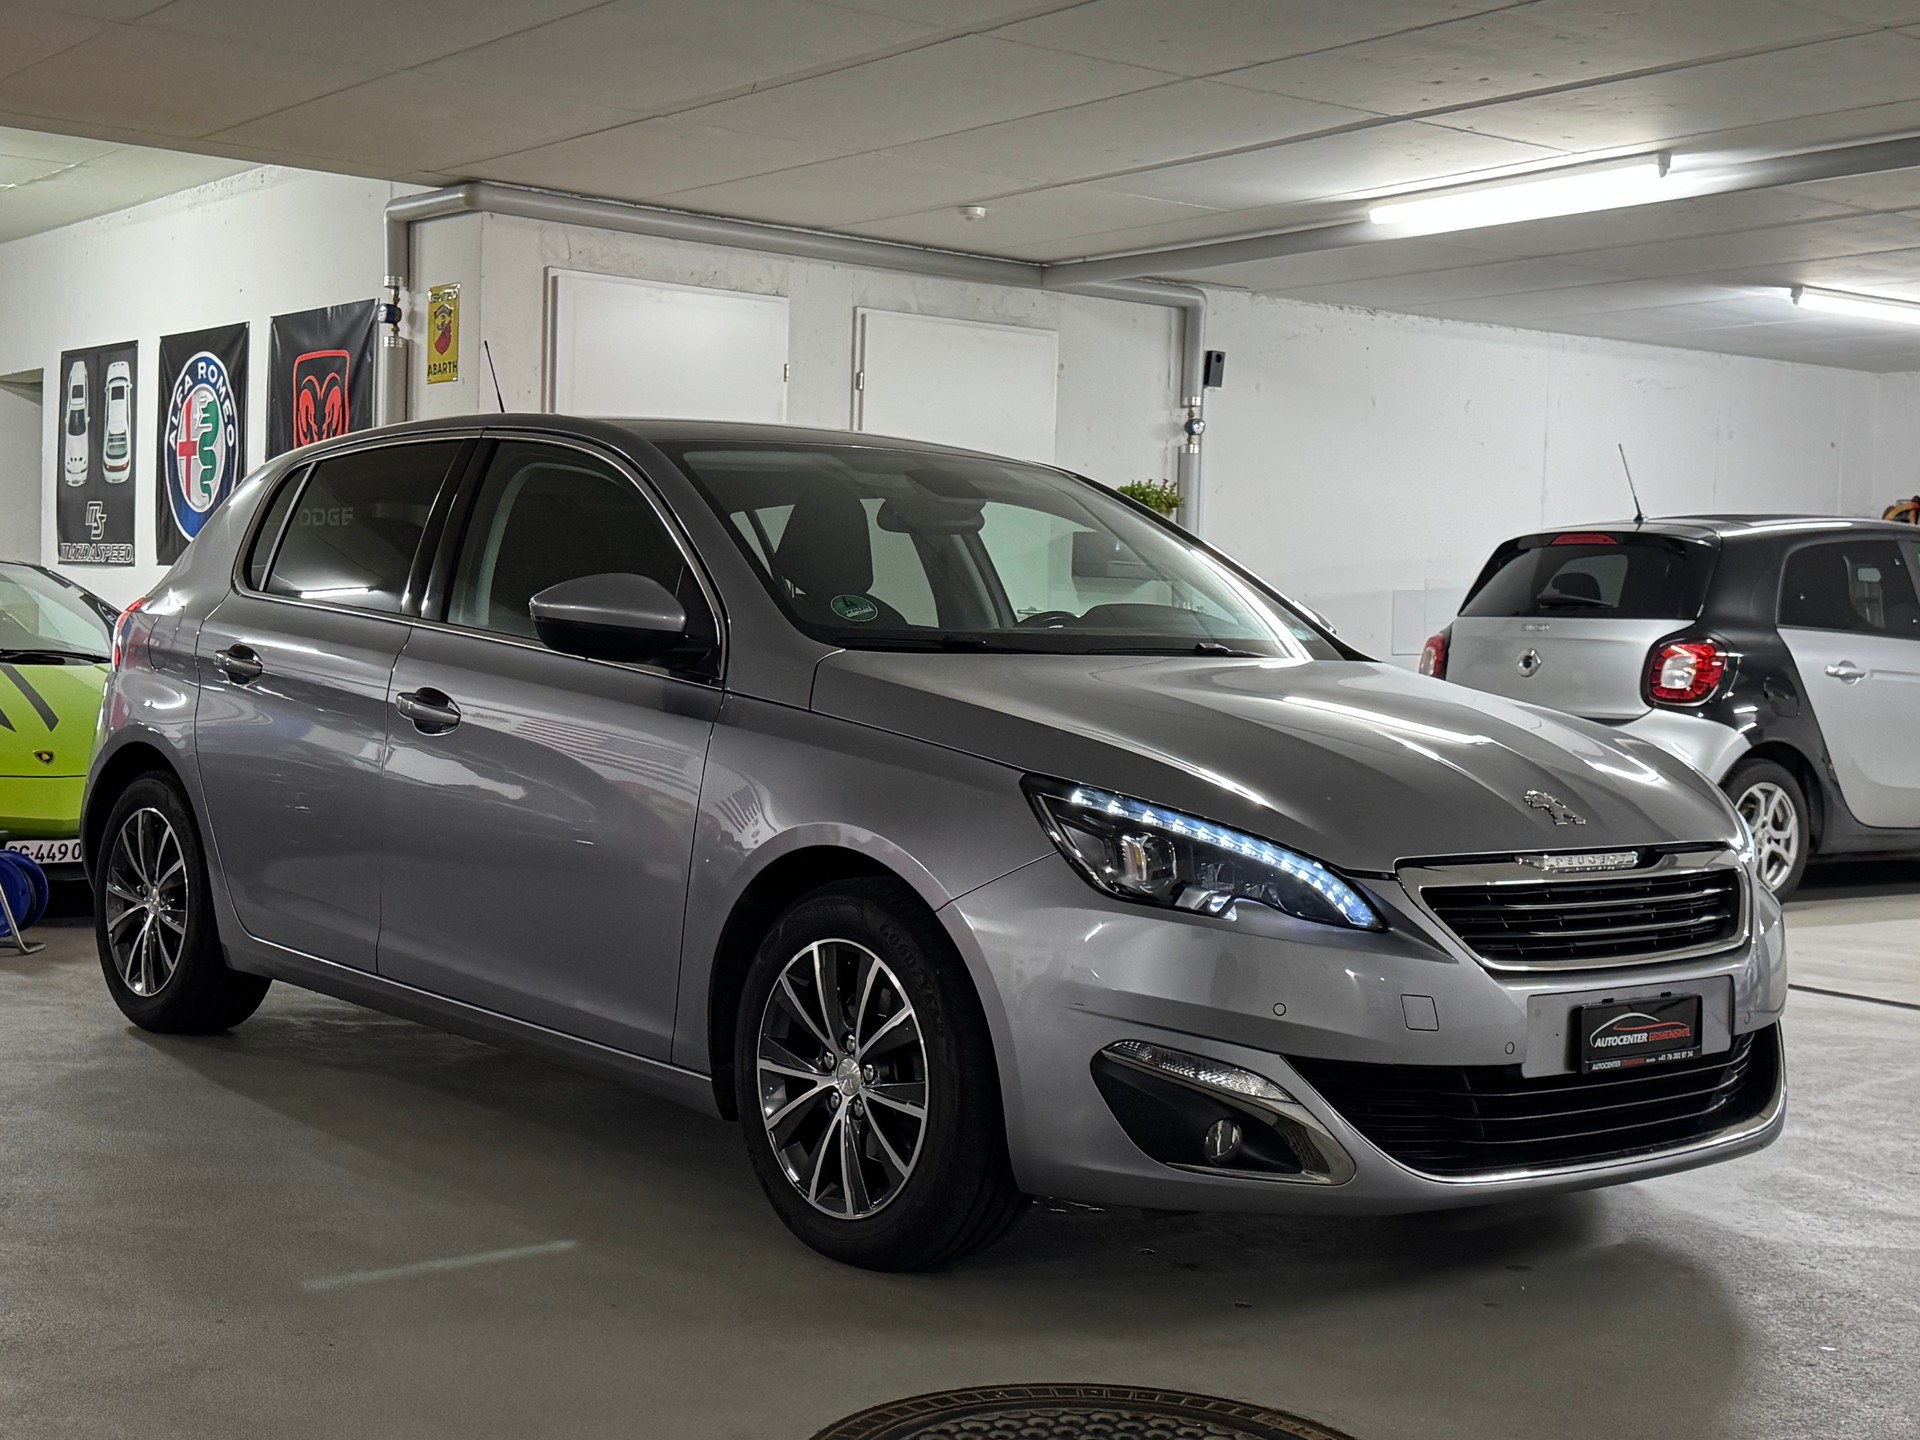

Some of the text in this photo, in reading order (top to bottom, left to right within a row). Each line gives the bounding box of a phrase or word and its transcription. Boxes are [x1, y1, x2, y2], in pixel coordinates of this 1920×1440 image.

[427, 361, 458, 377] ABARTH
[169, 361, 235, 450] ALFA ROMEO
[299, 506, 354, 527] ODGE
[59, 542, 134, 563] MAZDASPEED
[1594, 1032, 1649, 1048] AUTOCENTER
